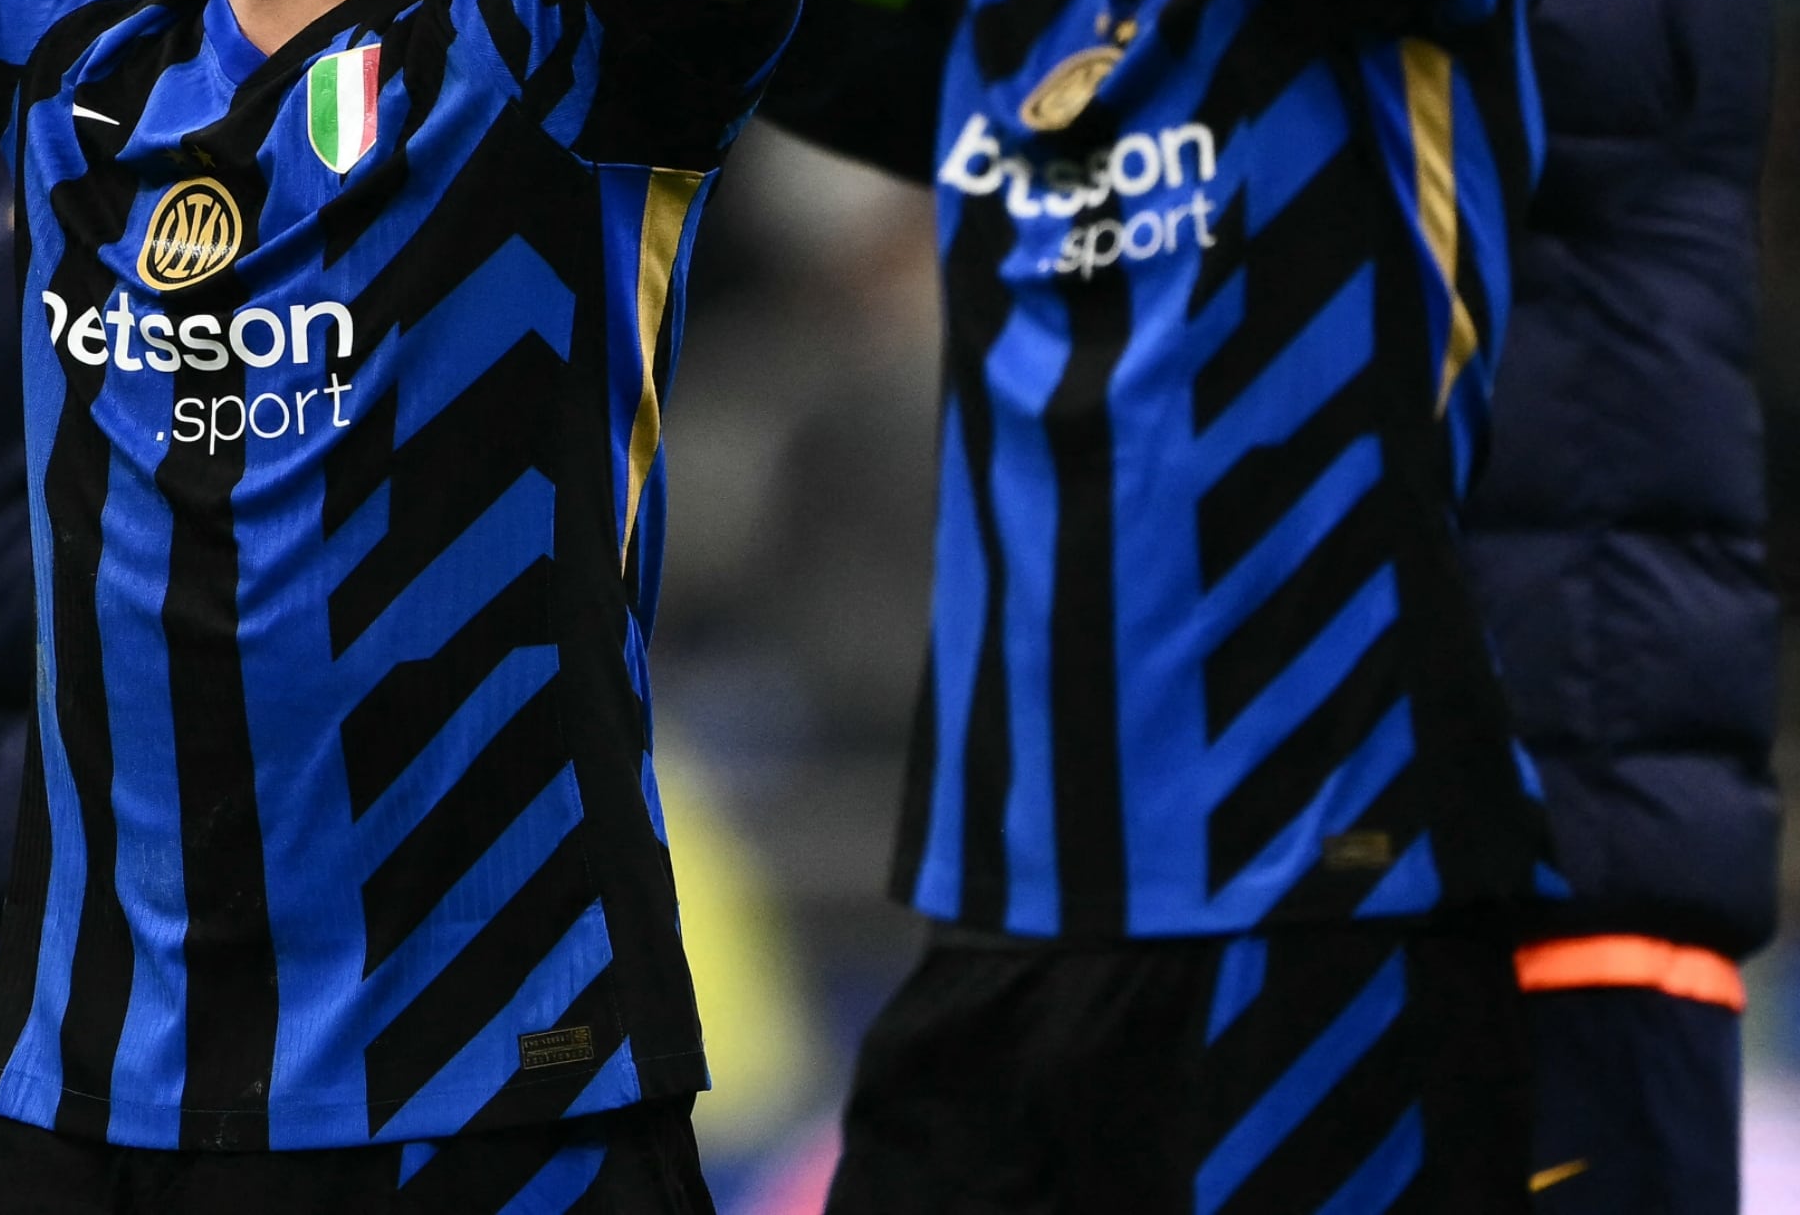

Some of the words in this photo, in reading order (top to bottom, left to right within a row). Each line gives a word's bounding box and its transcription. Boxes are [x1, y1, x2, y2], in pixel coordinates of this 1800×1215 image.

[937, 113, 1217, 219] btsson
[1036, 189, 1218, 282] .sport
[155, 372, 353, 456] .sport
